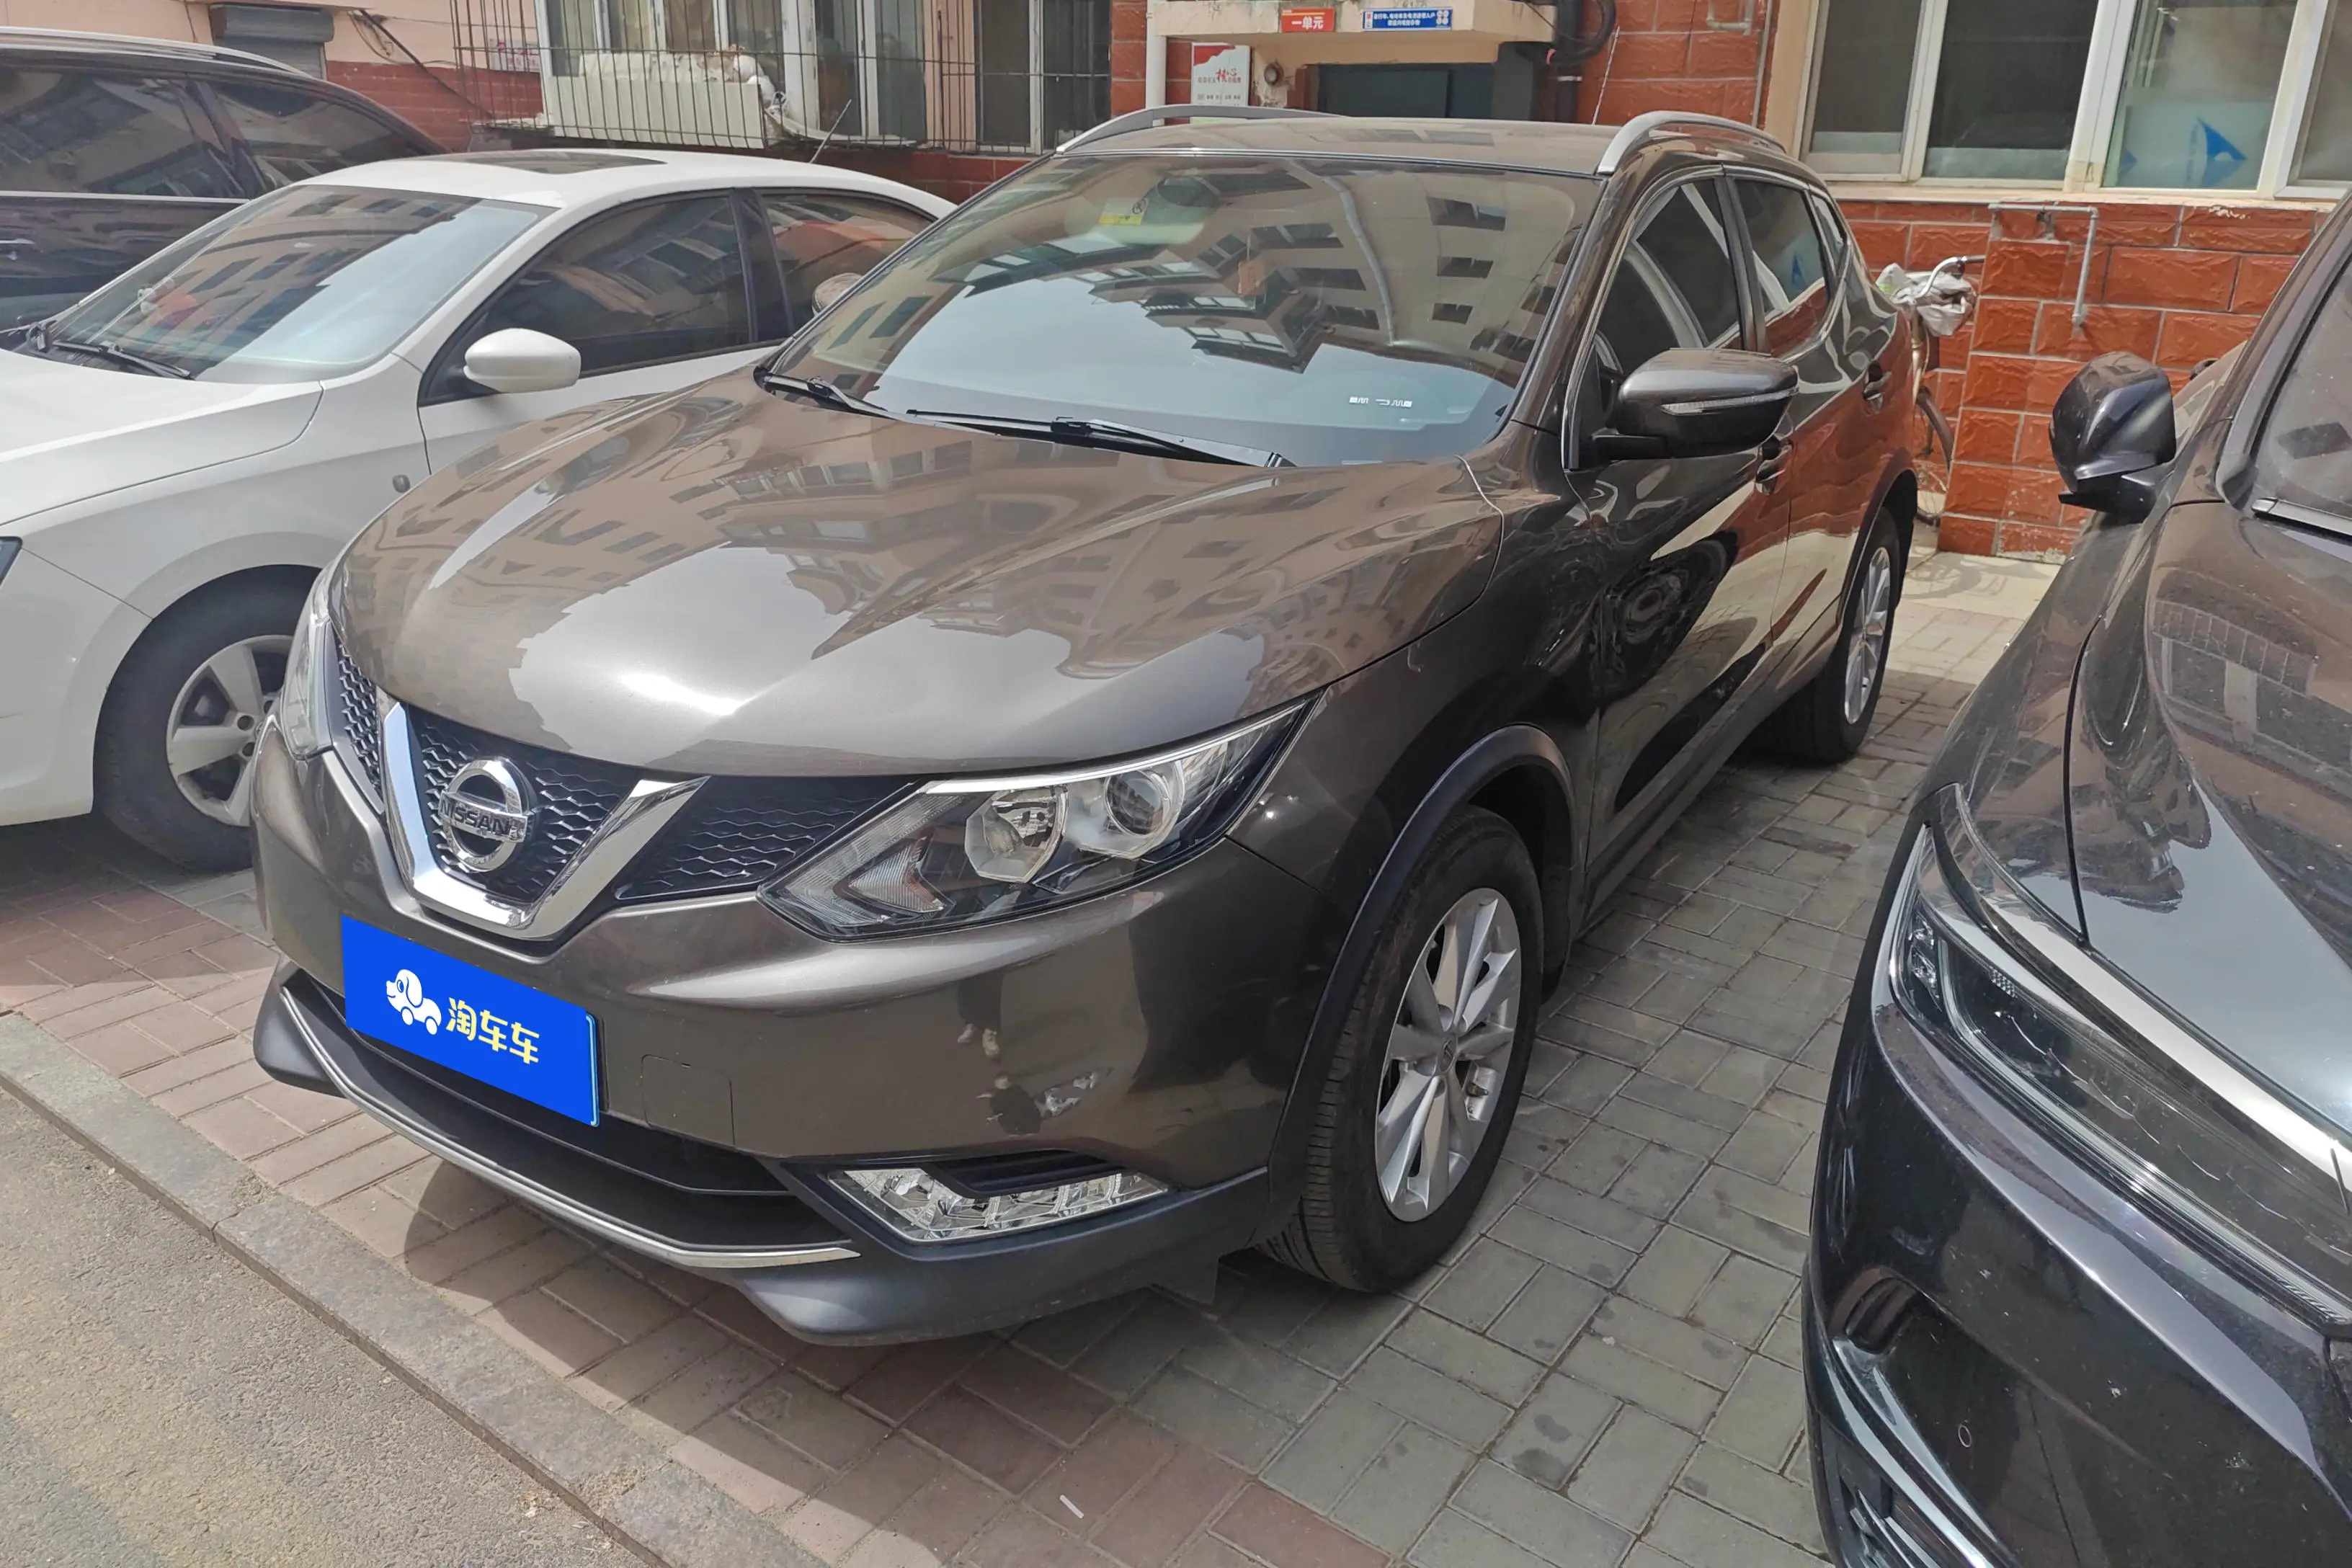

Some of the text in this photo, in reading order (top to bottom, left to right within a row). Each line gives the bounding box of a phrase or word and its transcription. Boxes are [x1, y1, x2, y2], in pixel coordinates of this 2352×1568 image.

[1291, 16, 1324, 30] 一单元
[440, 798, 510, 836] NISSAN
